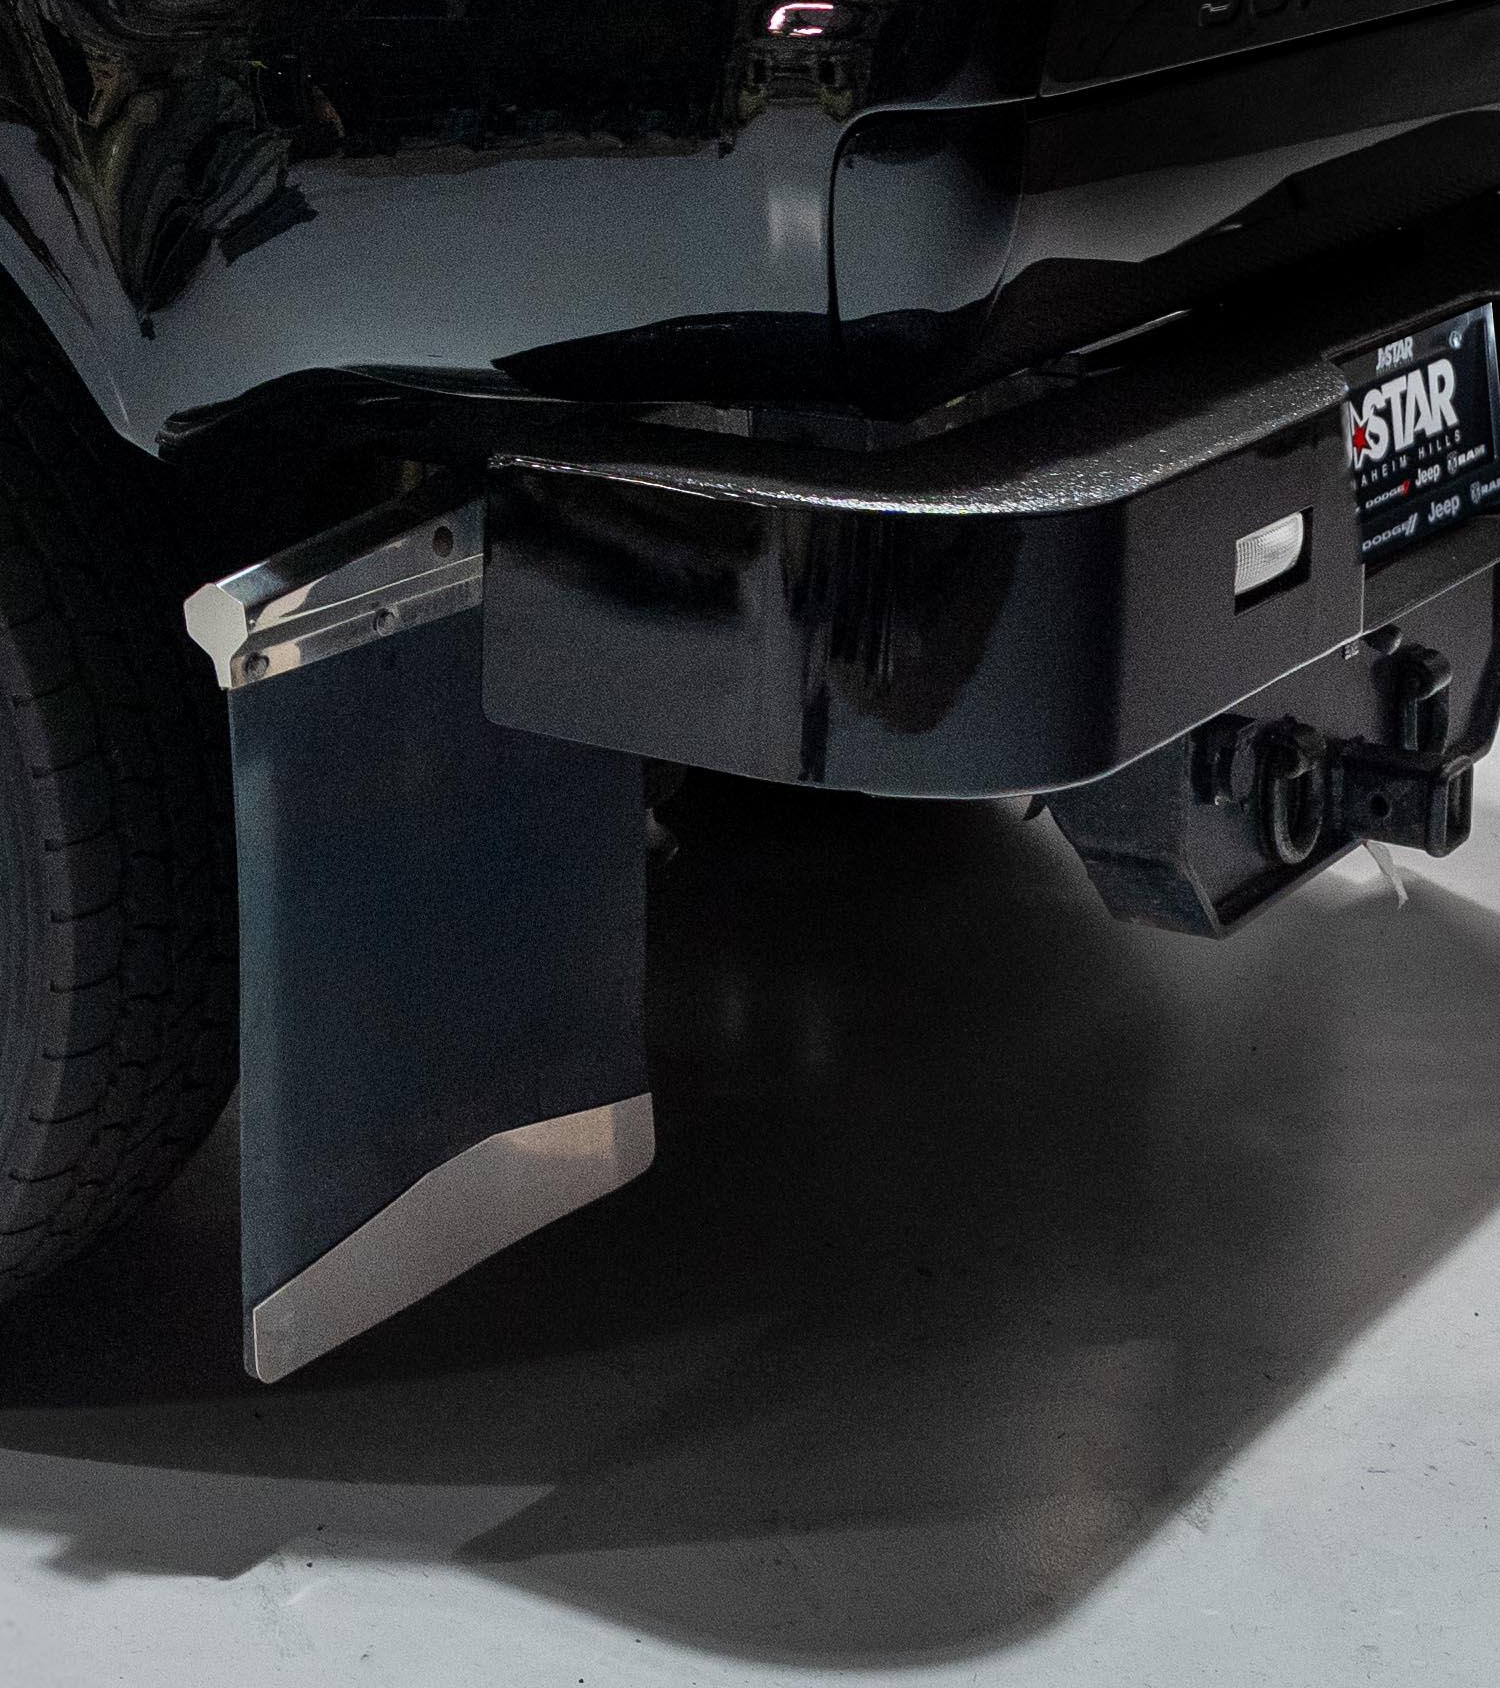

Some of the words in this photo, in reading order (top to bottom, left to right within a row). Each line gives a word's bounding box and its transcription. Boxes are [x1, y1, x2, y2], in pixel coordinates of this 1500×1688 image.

[1353, 454, 1408, 491] AHEIM
[1418, 429, 1461, 460] HILLS
[1365, 483, 1406, 509] DODGE
[1415, 464, 1441, 488] Jeep
[1458, 444, 1486, 465] RAM
[1362, 520, 1408, 551] DODGE
[1428, 495, 1460, 523] Jeep
